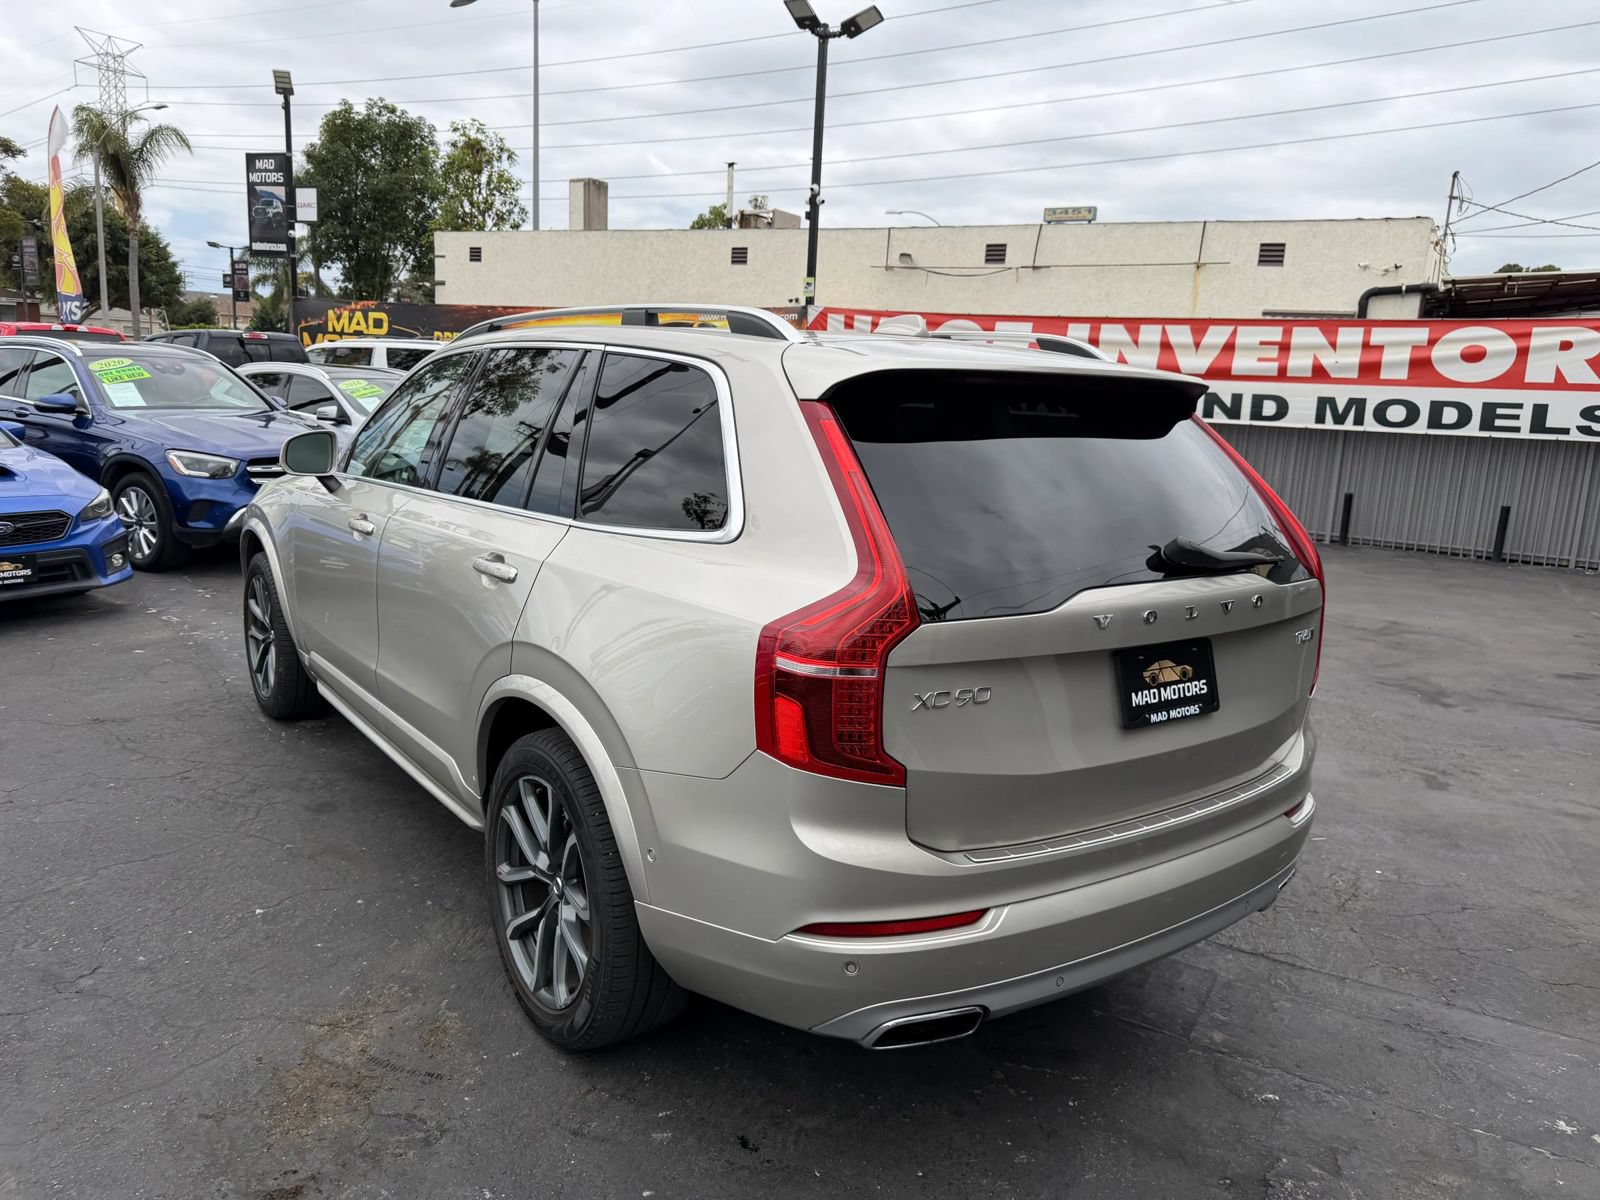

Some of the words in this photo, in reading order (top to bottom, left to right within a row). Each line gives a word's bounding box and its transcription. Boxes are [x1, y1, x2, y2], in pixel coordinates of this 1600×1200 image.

[255, 158, 275, 170] MAD
[248, 172, 284, 183] MOTORS
[297, 201, 316, 209] GMC
[327, 308, 389, 336] MAD
[96, 359, 124, 370] 2020
[126, 371, 145, 380] NEW
[2, 568, 33, 578] MOTORS
[1093, 593, 1264, 630] VOLVO
[911, 686, 993, 712] XC90
[1131, 686, 1159, 708] MAD
[1159, 679, 1208, 704] MOTORS
[1149, 711, 1169, 724] MAD
[1169, 704, 1201, 721] MOTORS
